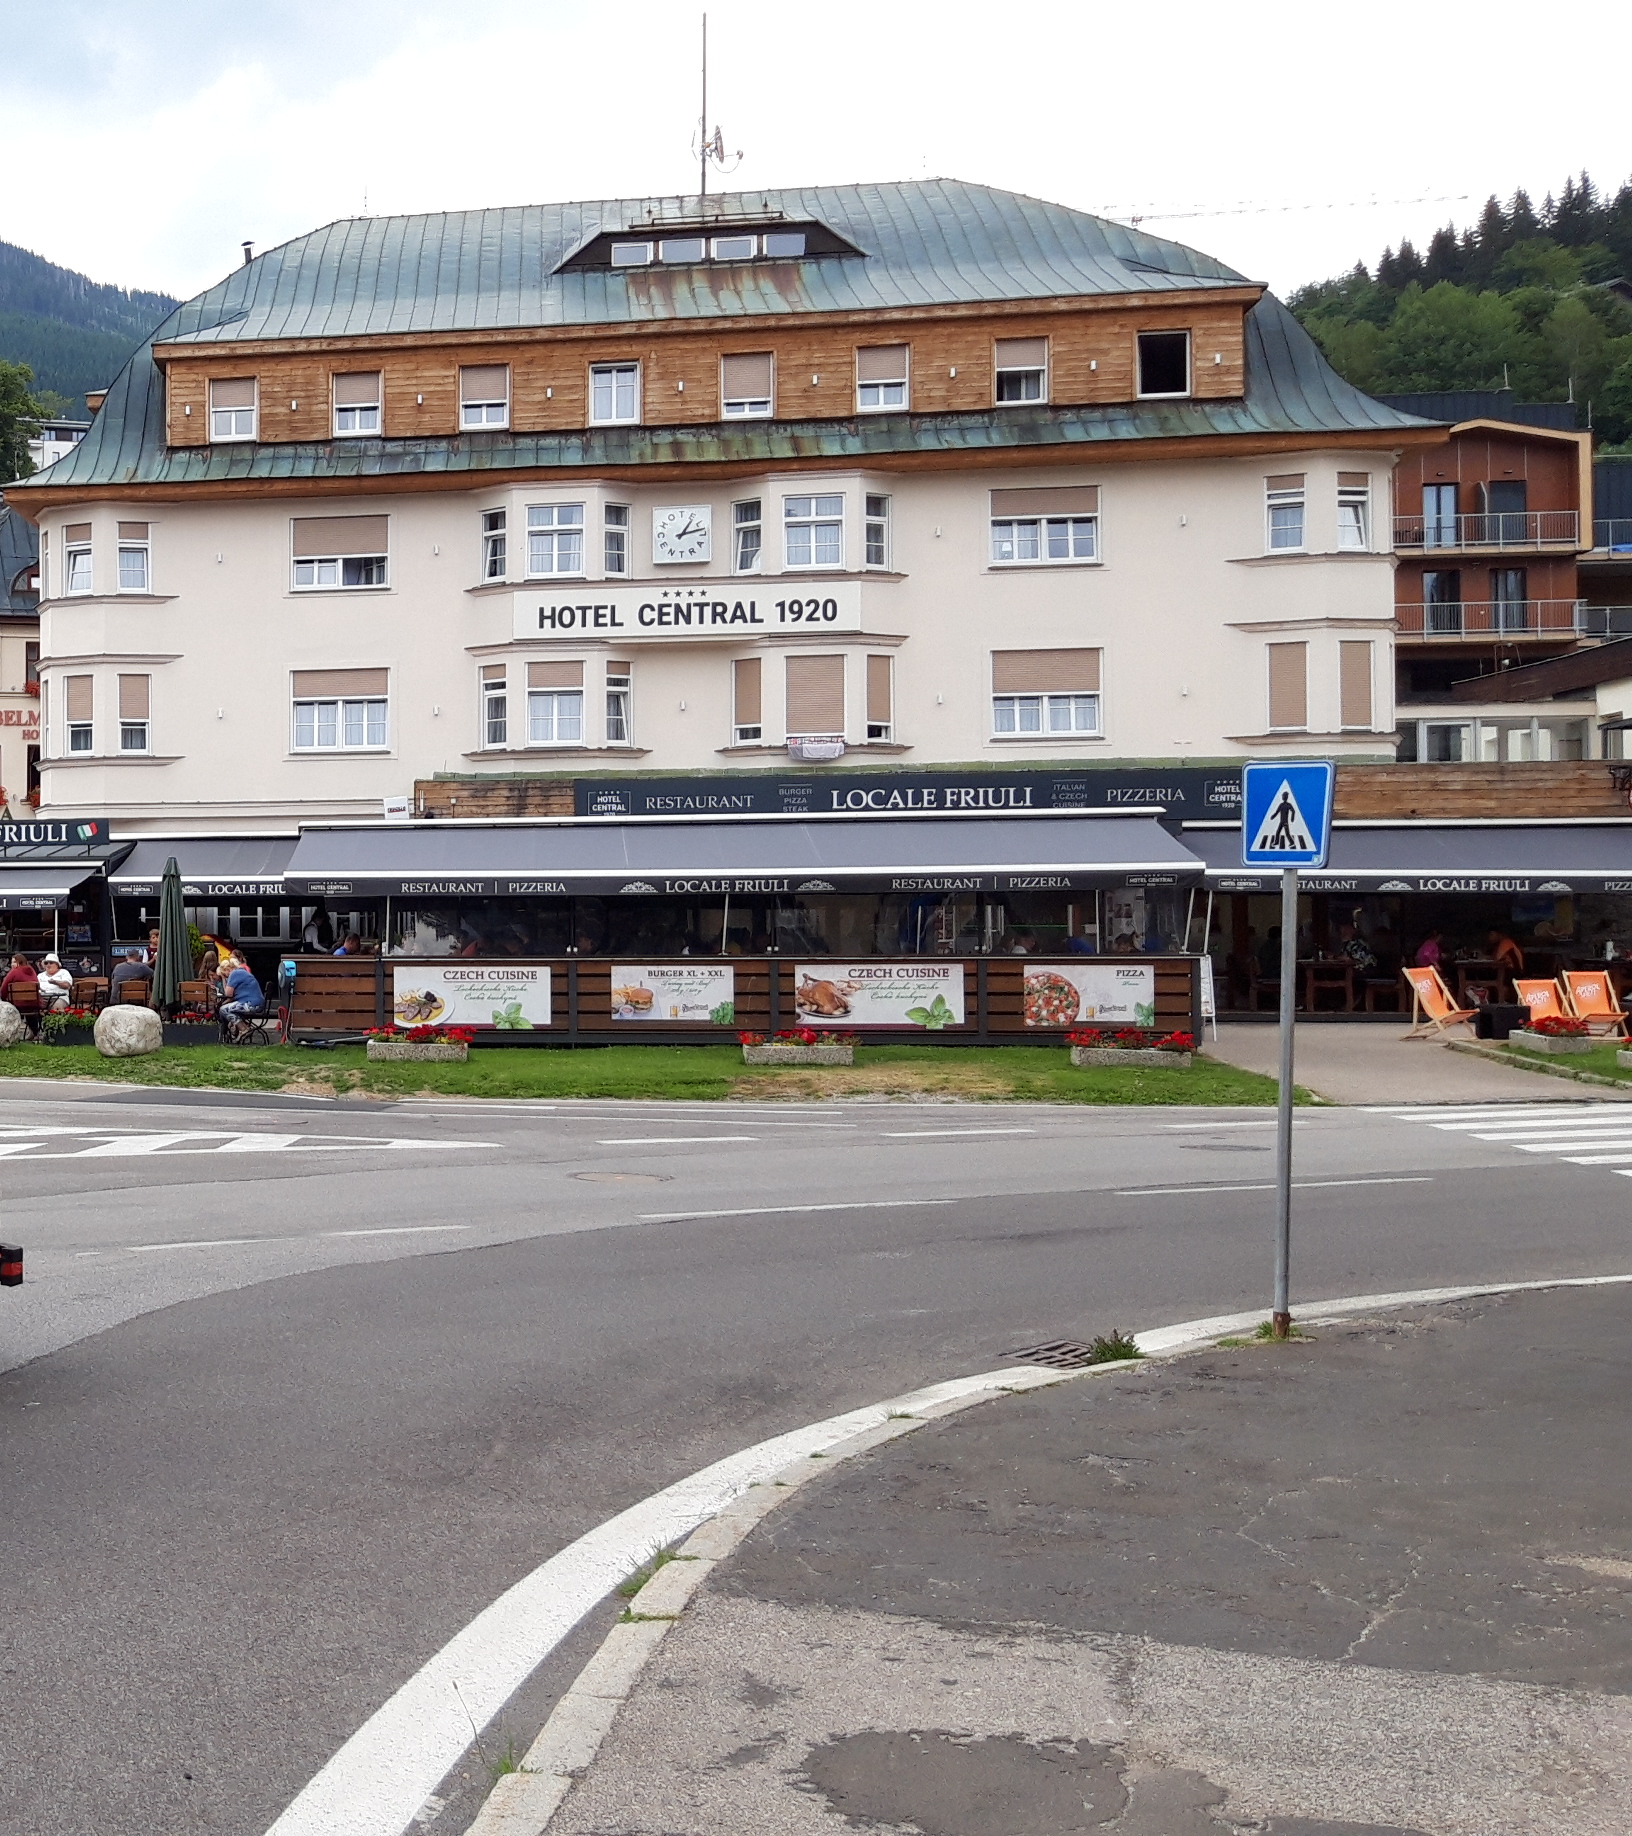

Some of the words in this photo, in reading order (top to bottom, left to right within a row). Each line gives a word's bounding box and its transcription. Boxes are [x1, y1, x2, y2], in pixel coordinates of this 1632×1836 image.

[538, 605, 624, 629] HOTEL
[638, 601, 764, 626] CENTRAL
[774, 598, 838, 623] 1920
[22, 730, 40, 740] HO
[831, 789, 937, 810] LOCALE
[944, 787, 1033, 808] FRIULI
[1107, 789, 1185, 802] PIZZERIA
[646, 795, 754, 809] RESTAURANT
[208, 884, 256, 894] LOCALE
[260, 884, 286, 894] FRIU
[401, 882, 484, 894] RESTAURANT
[508, 882, 566, 893] PIZZERIA
[664, 880, 730, 893] LOCALE
[734, 879, 789, 892] FRIULI
[892, 878, 982, 890] RESTAURANT
[1009, 877, 1071, 888] PIZZERIA
[1419, 879, 1477, 891] LOCALE
[1481, 880, 1529, 891] FRIULI
[1604, 881, 1632, 891] PIZZ
[443, 970, 485, 980] CZECH
[488, 970, 537, 980] CUISINE
[848, 968, 892, 978] CZECH
[896, 968, 949, 978] CUISINE
